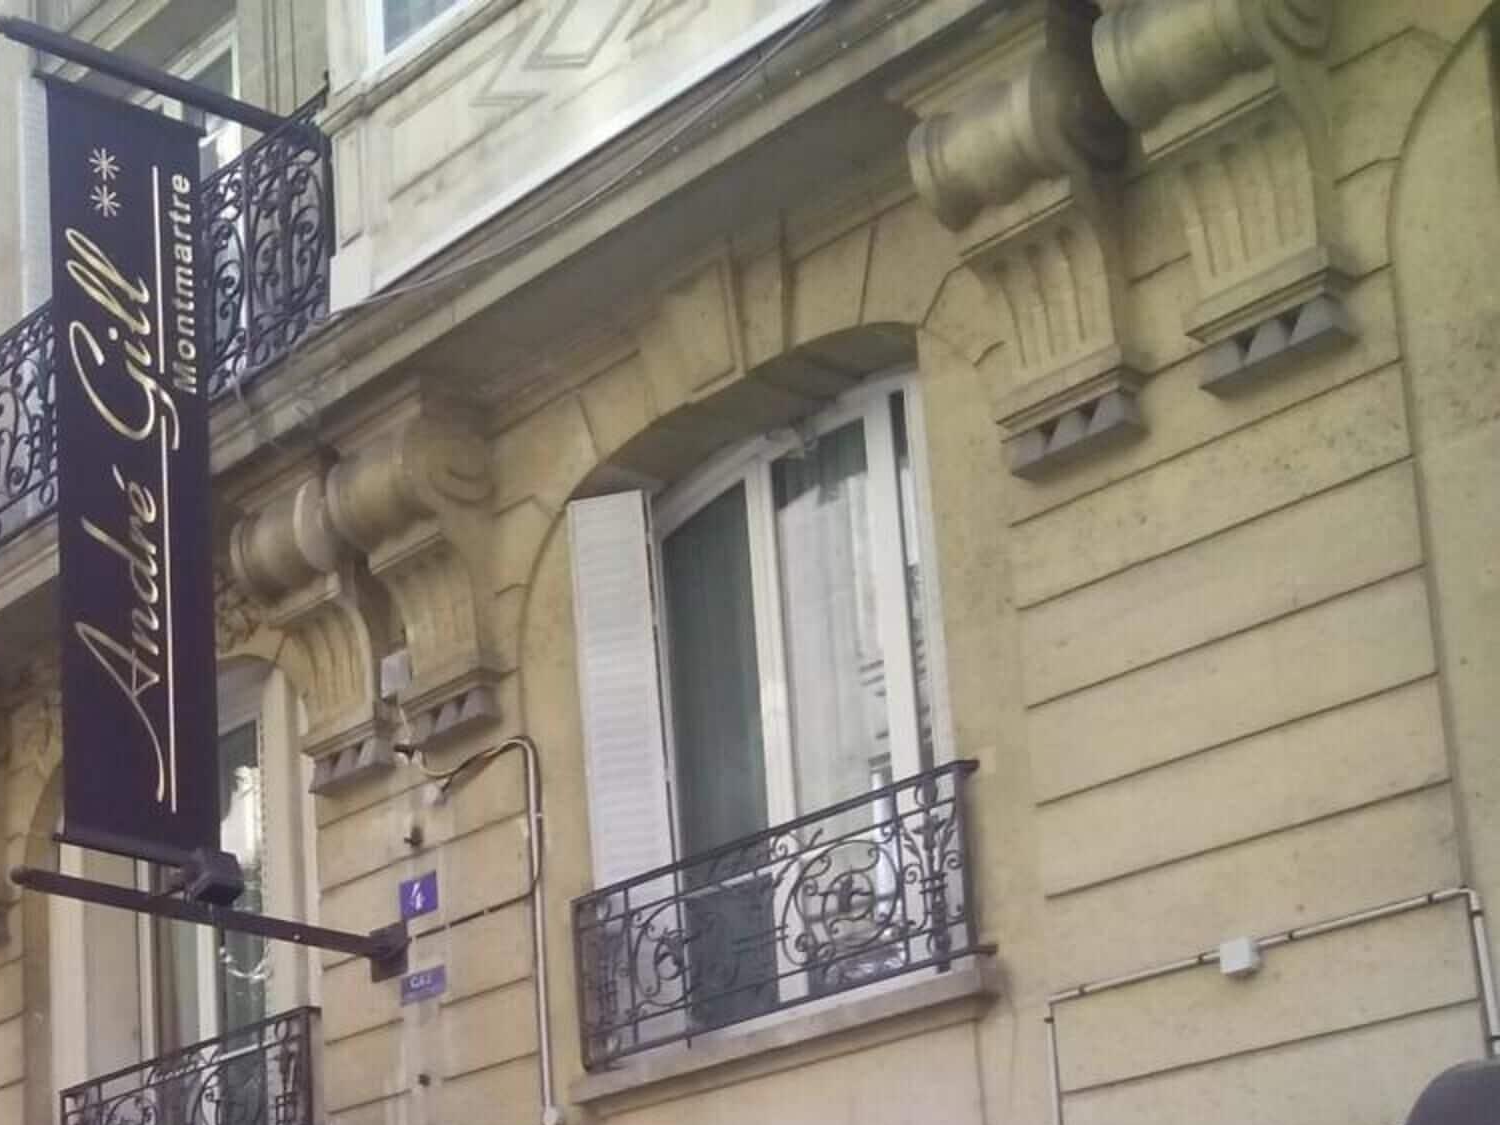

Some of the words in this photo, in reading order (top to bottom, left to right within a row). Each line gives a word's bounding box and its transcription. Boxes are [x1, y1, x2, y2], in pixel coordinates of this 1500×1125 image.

[65, 227, 179, 450] Gill
[171, 173, 197, 395] Montmartre
[73, 464, 165, 803] André
[410, 882, 426, 911] 4
